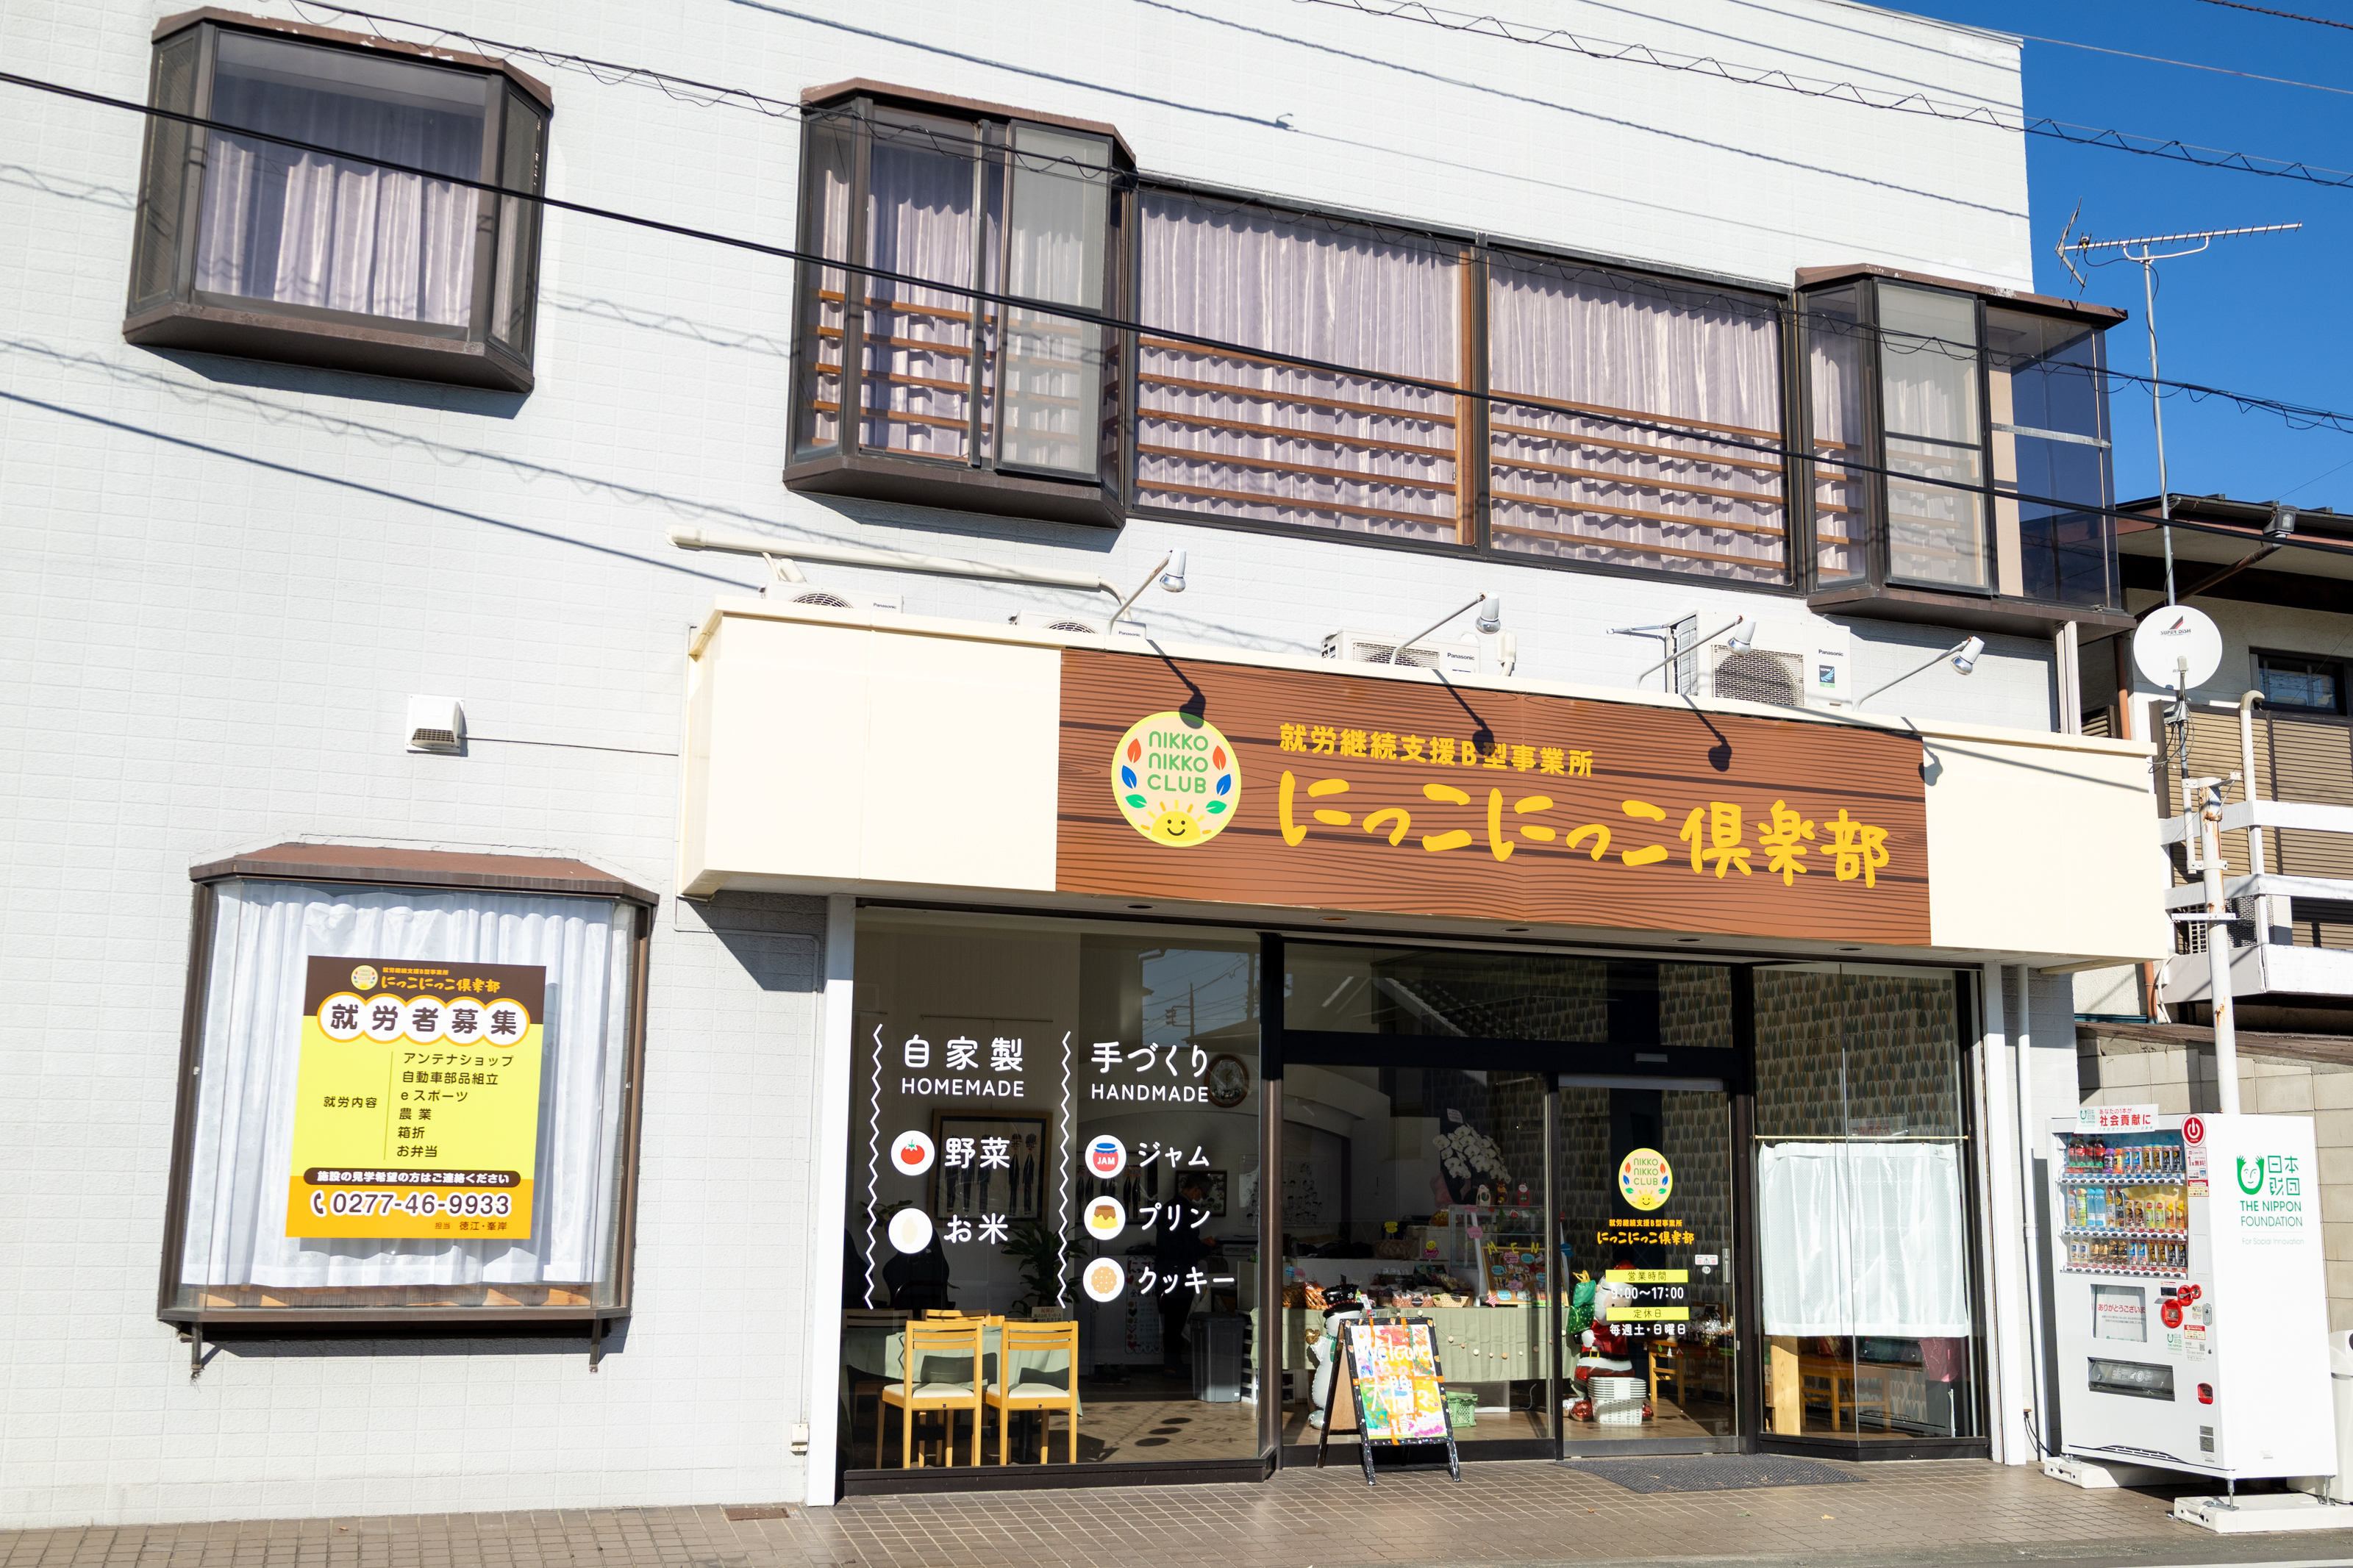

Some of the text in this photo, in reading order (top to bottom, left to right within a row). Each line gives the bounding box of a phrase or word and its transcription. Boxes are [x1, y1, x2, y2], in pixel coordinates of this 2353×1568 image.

[1447, 652, 1475, 661] Panasonic
[1149, 731, 1208, 751] NIKKO
[1279, 723, 1593, 778] 就労継続支援B型事業所
[1149, 752, 1208, 773] NIKKO
[1148, 774, 1207, 794] CLUB
[1279, 770, 1890, 889] にっこにっこ倶楽部
[381, 975, 501, 993] にっこにっこ倶楽部
[330, 1003, 516, 1035] 就労者募集
[404, 1053, 514, 1067] アンテナショップ
[904, 1034, 1023, 1072] 自家製
[1090, 1041, 1207, 1078] 手づくり
[403, 1071, 499, 1085] 自動車部品組立
[901, 1077, 1024, 1097] HOMEMADE
[1091, 1083, 1209, 1103] HANDMADE
[324, 1096, 377, 1109] 就労内容
[2099, 1114, 2151, 1126] 社会貢献に
[398, 1126, 425, 1139] 箱折
[397, 1145, 438, 1157] お弁当
[944, 1136, 1010, 1170] 野菜
[1138, 1141, 1210, 1167] ジャム
[1097, 1156, 1115, 1165] JAM
[1634, 1158, 1658, 1166] NIKKO
[2267, 1155, 2299, 1173] 日本
[317, 1170, 509, 1184] 施設の見学希望の方はご連絡ください
[1634, 1167, 1658, 1175] NIKKO
[333, 1193, 509, 1214] 0277-46-9933
[2240, 1200, 2302, 1211] THE NIPPON
[1139, 1202, 1210, 1231] プリン
[1609, 1219, 1682, 1227] 就労継続支援B型事業所
[2240, 1216, 2302, 1227] FOUNDATION
[943, 1213, 1008, 1245] お米
[1597, 1230, 1694, 1245] にっこにっこ倶楽部
[1138, 1266, 1235, 1295] クッキー
[1627, 1271, 1666, 1281] 営業時間
[1633, 1309, 1661, 1318] 定休日
[2098, 1303, 2146, 1314] ありがとうございま
[1610, 1323, 1686, 1336] 毎週土・日曜日
[1365, 1334, 1429, 1361] Welcome
